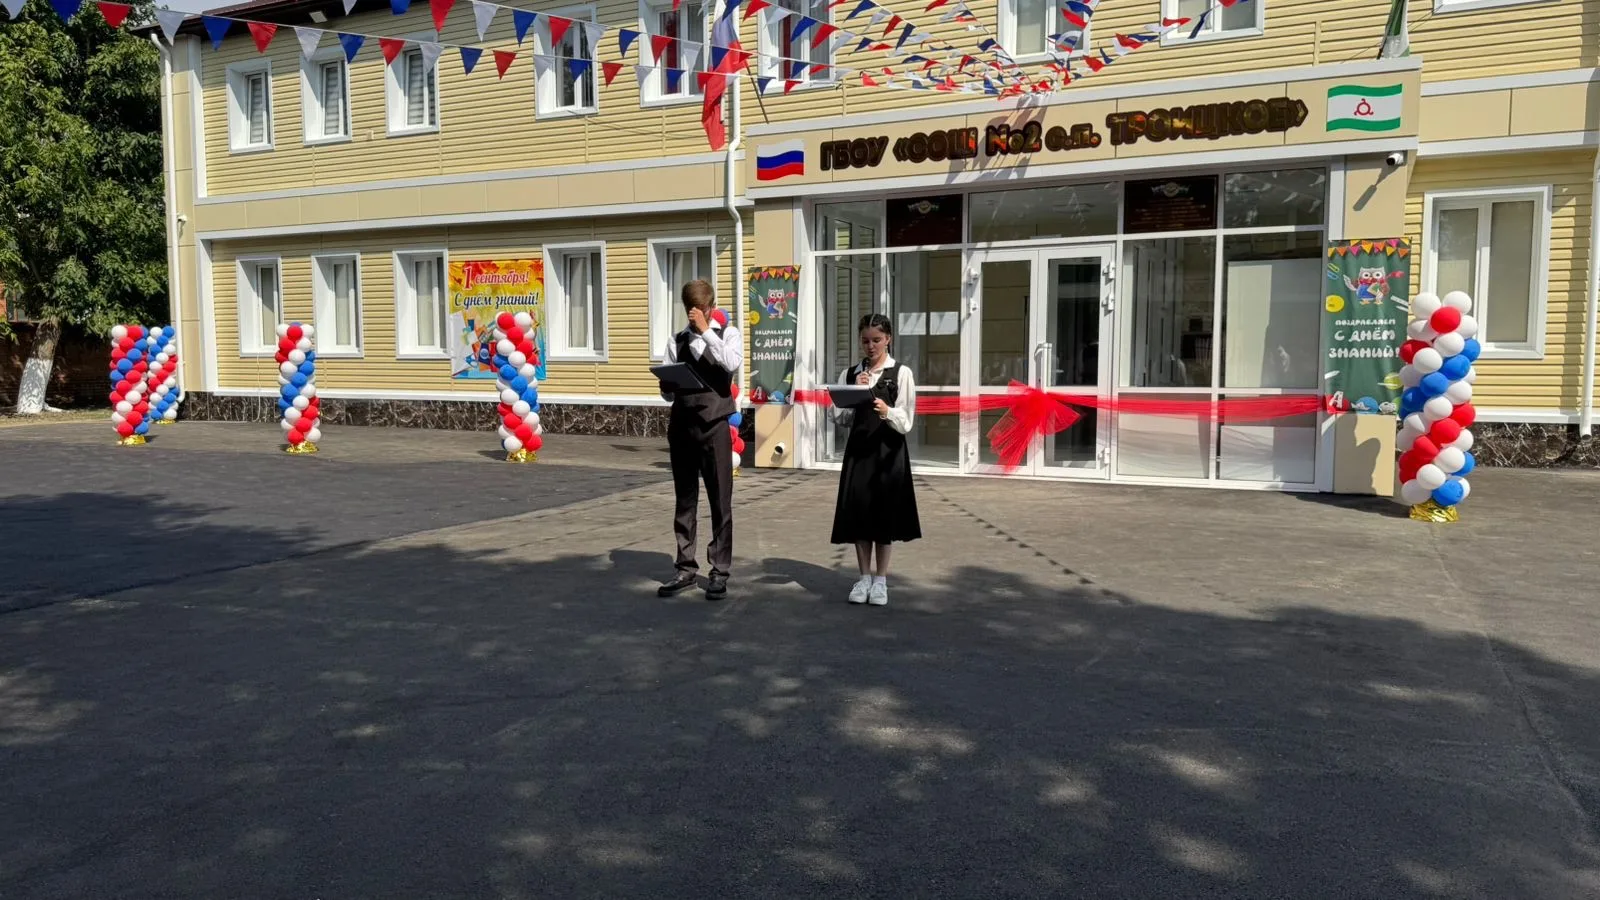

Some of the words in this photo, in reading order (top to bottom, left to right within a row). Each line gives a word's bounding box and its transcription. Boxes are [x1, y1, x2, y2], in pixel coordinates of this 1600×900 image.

[820, 136, 889, 171] ГБОУ
[464, 266, 473, 290] 1
[475, 270, 529, 286] сентября!
[454, 293, 462, 306] С
[463, 293, 492, 309] днём
[495, 291, 539, 308] знаний!
[754, 338, 761, 347] С
[763, 336, 793, 348] ДНЁМ
[1334, 330, 1345, 341] С
[1348, 327, 1396, 342] ДНЁМ
[1328, 345, 1400, 358] ЗНАНИЙ!
